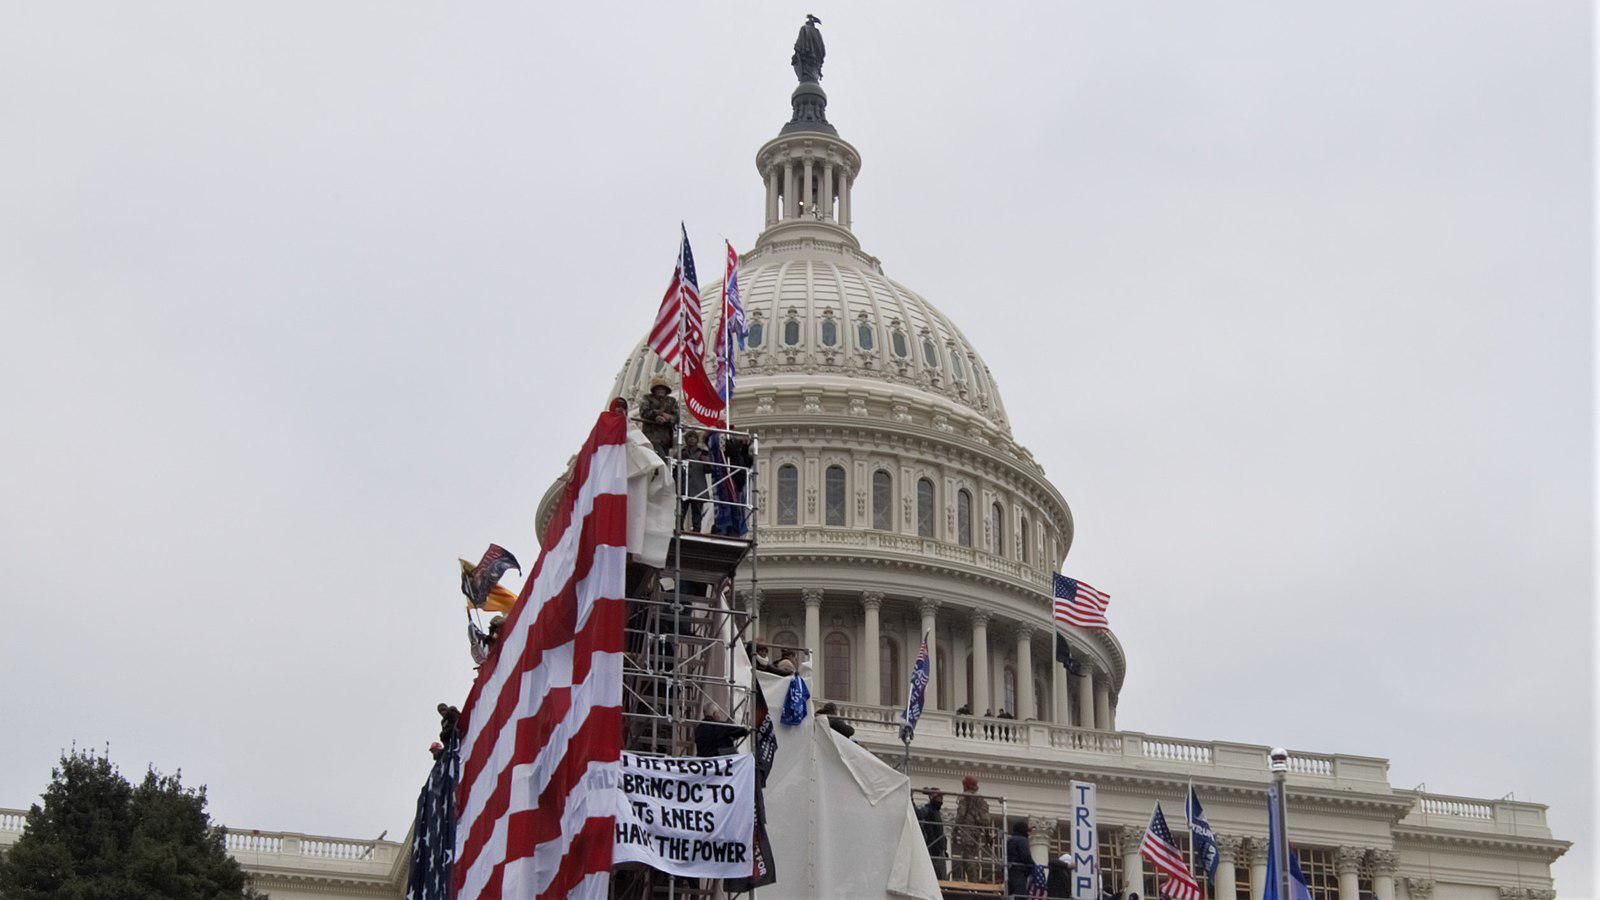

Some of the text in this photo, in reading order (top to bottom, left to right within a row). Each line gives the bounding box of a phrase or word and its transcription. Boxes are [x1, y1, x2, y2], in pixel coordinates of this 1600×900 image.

[665, 759, 733, 776] PEOPLE
[677, 780, 703, 804] DC
[706, 784, 735, 804] TO
[655, 836, 690, 861] THE
[691, 840, 747, 863] POWER
[1075, 786, 1095, 897] TRUMP
